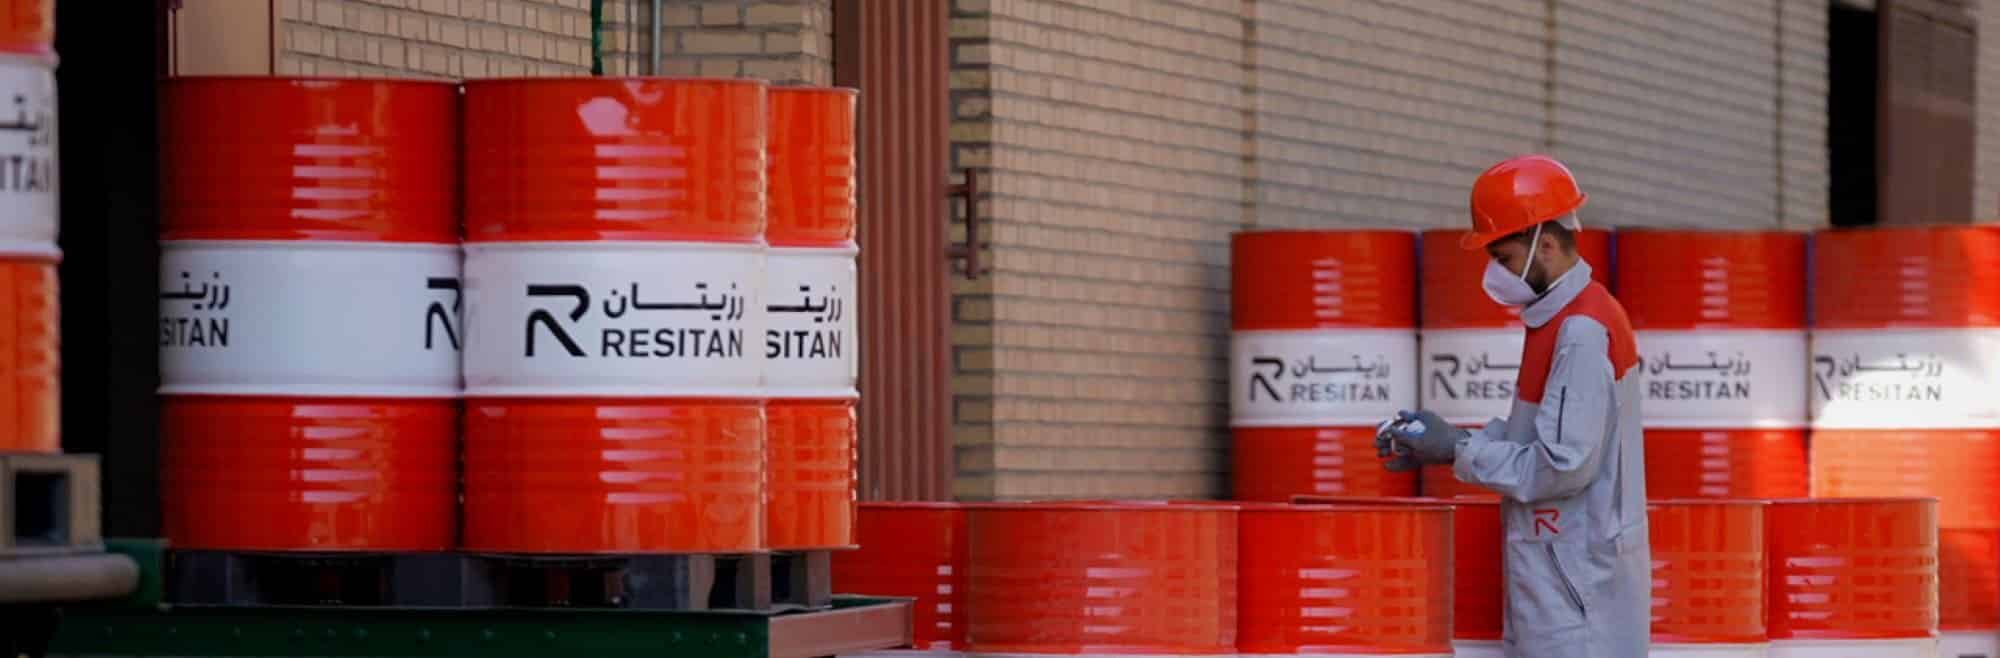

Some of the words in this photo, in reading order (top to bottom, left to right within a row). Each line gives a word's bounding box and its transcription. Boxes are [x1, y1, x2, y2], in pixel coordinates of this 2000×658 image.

[160, 317, 229, 347] SITAN
[601, 328, 743, 358] RESITAN
[765, 329, 841, 359] SITAN
[1290, 383, 1390, 401] RESITAN
[1649, 380, 1750, 400] RESITAN
[1840, 383, 1942, 400] RESITAN
